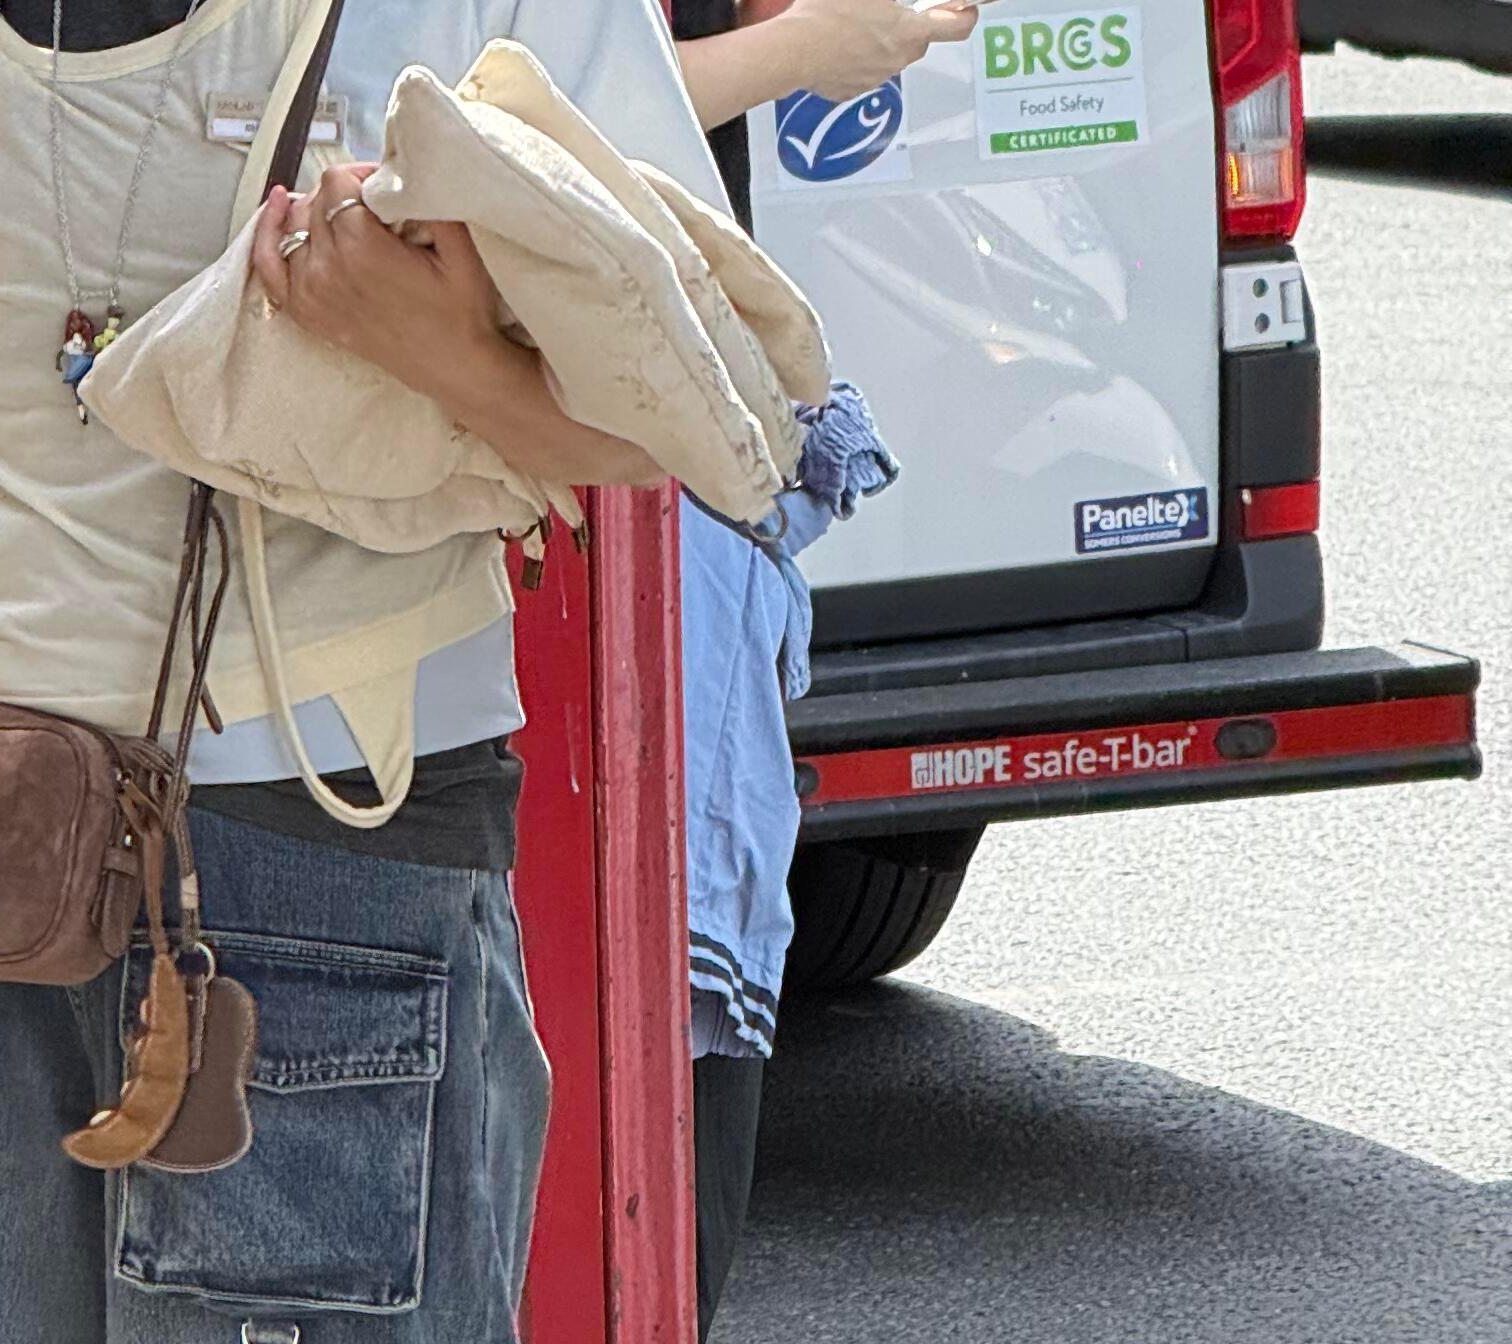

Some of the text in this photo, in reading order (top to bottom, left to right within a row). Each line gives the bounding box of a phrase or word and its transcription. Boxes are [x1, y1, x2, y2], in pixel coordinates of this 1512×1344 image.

[1020, 94, 1104, 116] Food Safety
[1008, 126, 1118, 150] CERTIFICATED
[934, 733, 1191, 787] HOPE safe-T-bar
